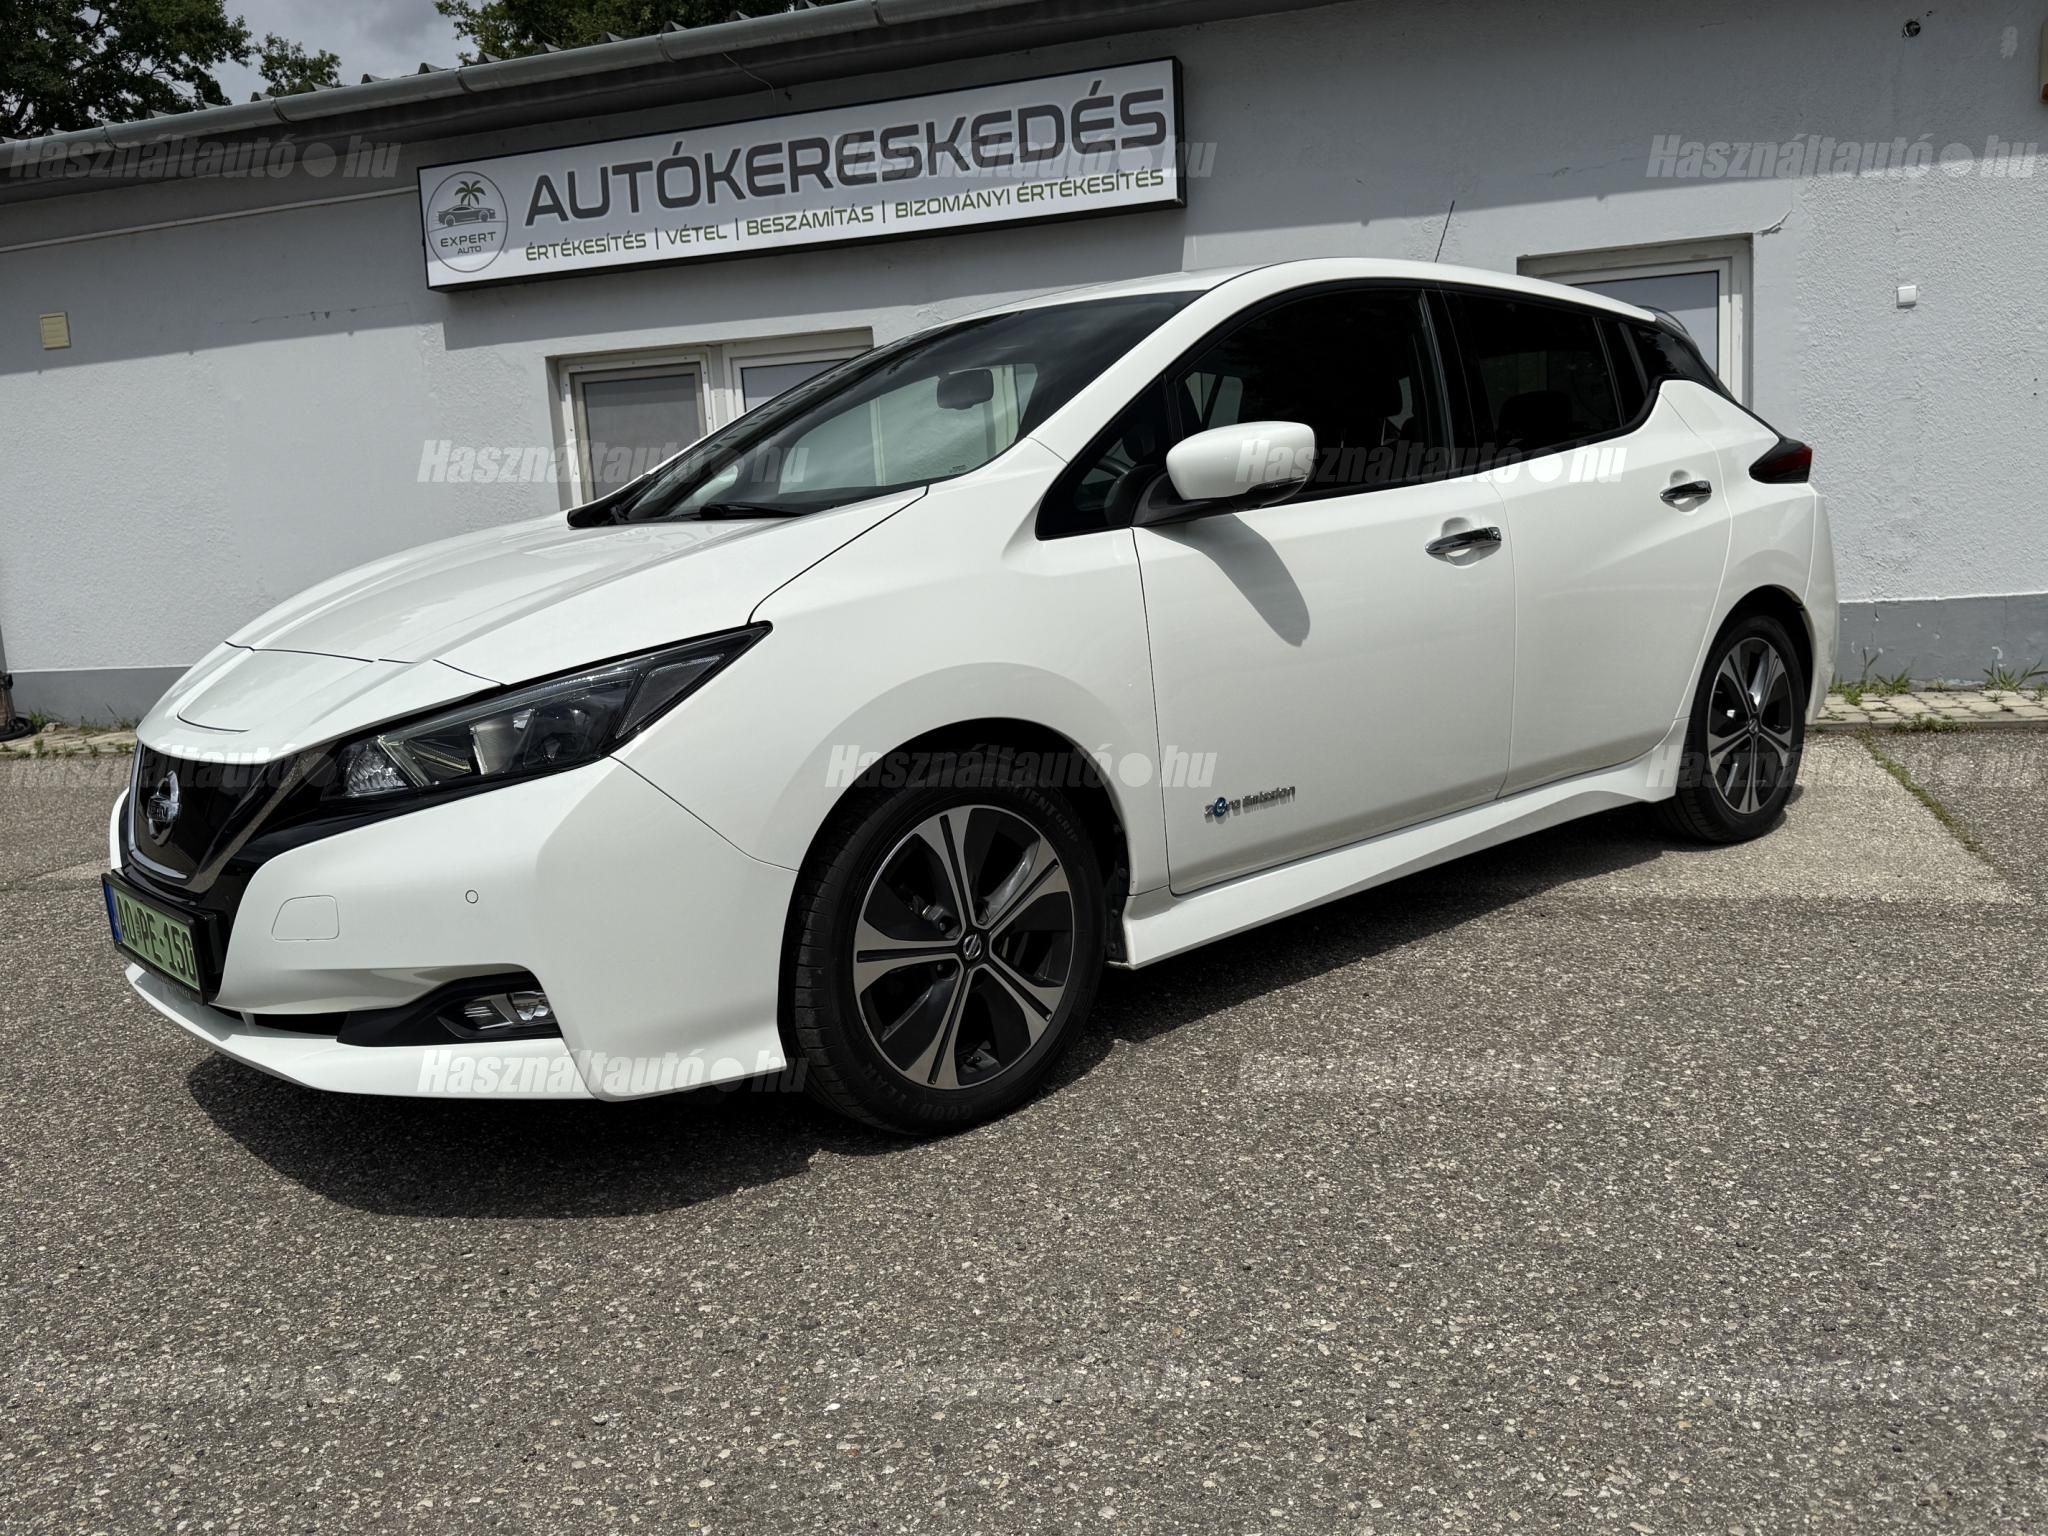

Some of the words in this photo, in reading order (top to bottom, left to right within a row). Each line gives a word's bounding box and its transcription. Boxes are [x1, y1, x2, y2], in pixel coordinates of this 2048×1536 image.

[525, 81, 1167, 226] AUTÓKERESKEDÉS
[440, 231, 497, 248] EXPERT
[526, 231, 647, 261] ÉRTÉKESÍTÉS
[665, 223, 728, 246] VÉTEL
[746, 202, 874, 236] BESZÁMÍTÁS
[895, 187, 1011, 218] BIZOMÁNYI
[1016, 165, 1164, 204] ÉRTÉKESÍTÉS
[457, 245, 482, 255] AUTO
